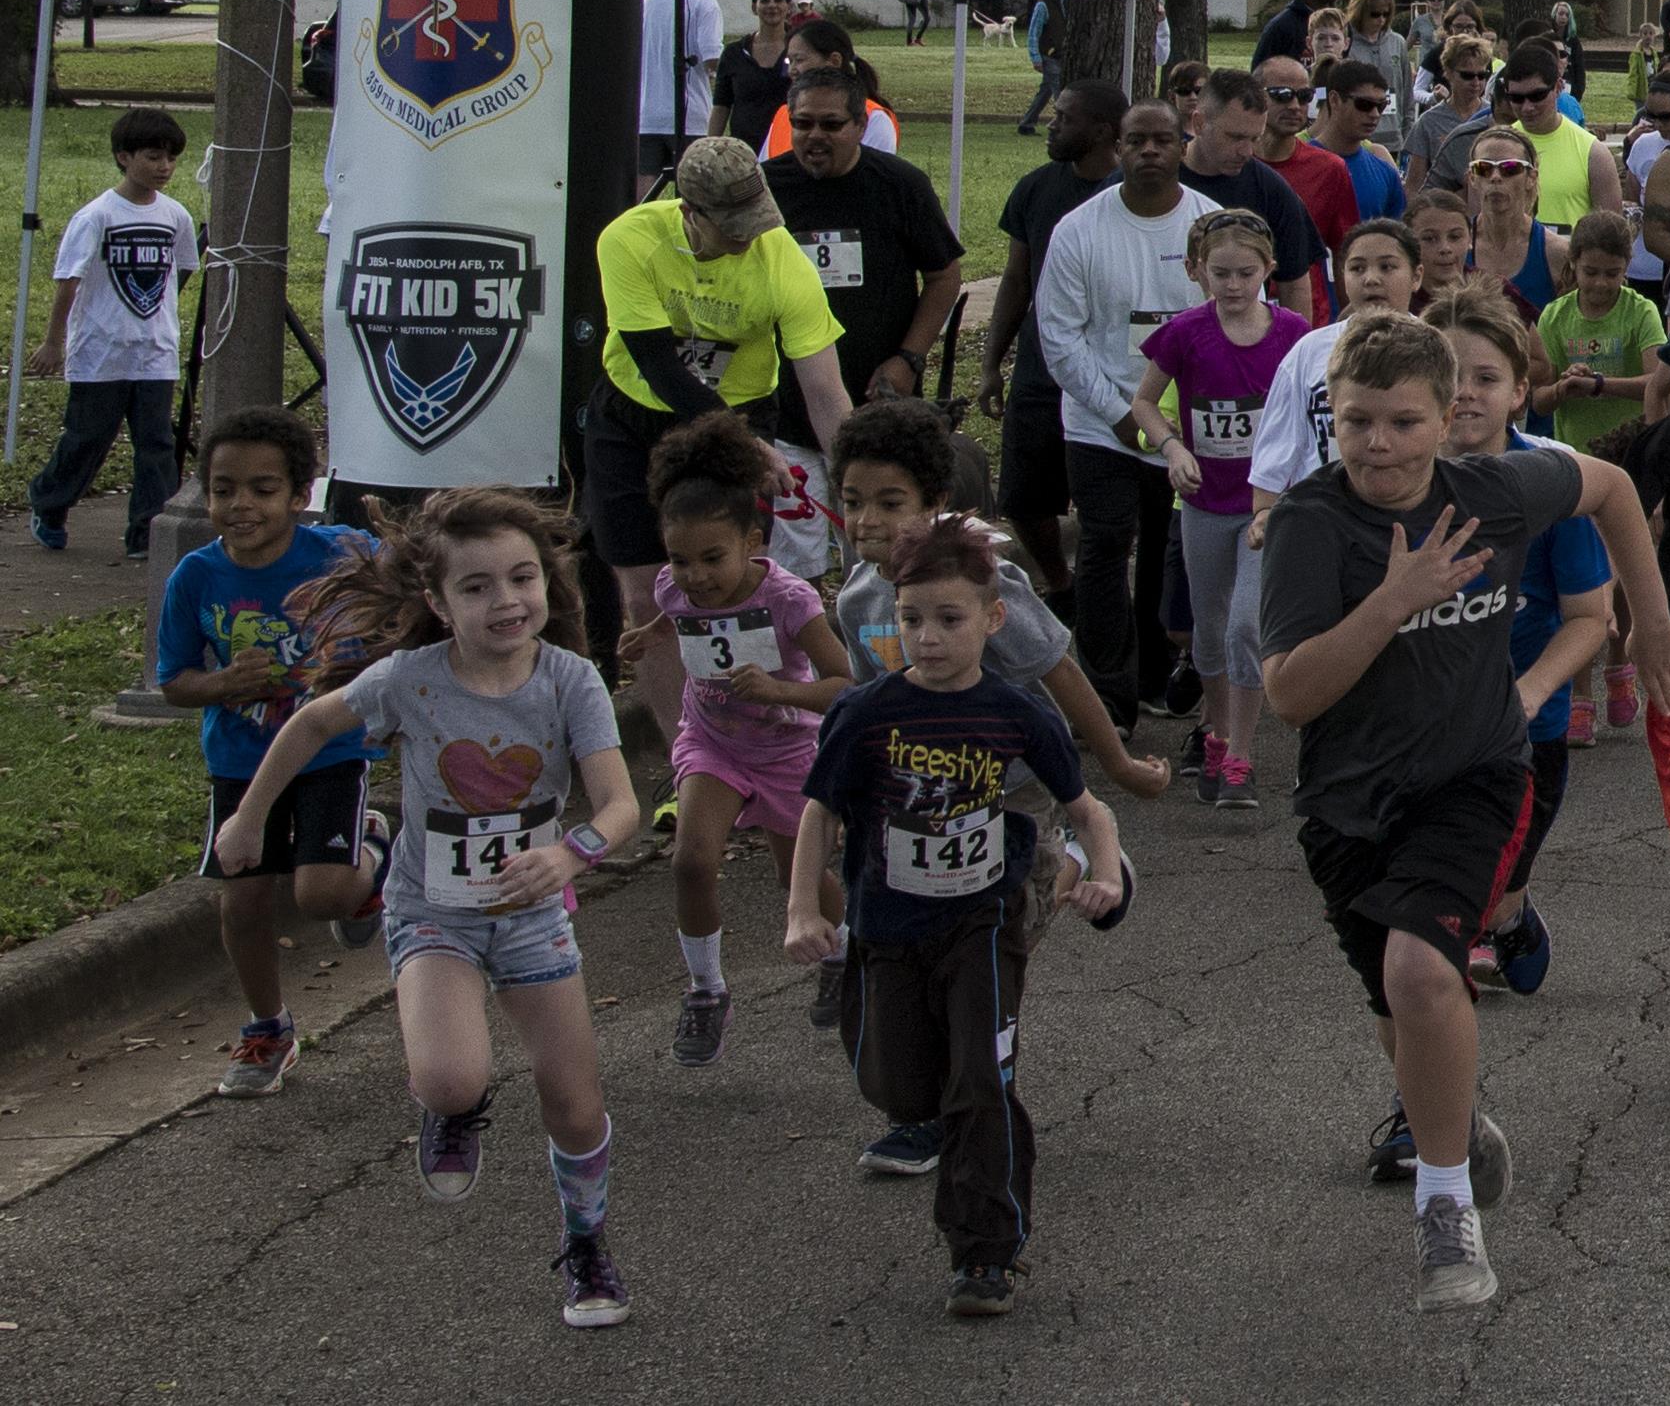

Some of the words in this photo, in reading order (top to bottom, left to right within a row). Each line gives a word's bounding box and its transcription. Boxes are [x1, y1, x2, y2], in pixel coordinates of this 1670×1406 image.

[366, 70, 395, 112] 359TH
[396, 99, 467, 140] MEDICAL
[471, 73, 530, 119] GROUP
[109, 246, 131, 264] FIT
[137, 246, 159, 263] KID
[368, 257, 388, 267] JBSA
[396, 259, 456, 269] RANDOLPH
[459, 259, 486, 272] AFB,
[488, 260, 505, 270] TX
[351, 273, 392, 317] FIT
[401, 278, 459, 317] KID
[474, 277, 523, 320] 5K
[400, 326, 447, 335] NUTRITION
[458, 327, 498, 336] FITNESS
[1202, 413, 1253, 439] 173
[1397, 584, 1508, 634] idas
[710, 636, 735, 670] 3
[886, 727, 1004, 791] freestyle
[911, 828, 989, 871] 142
